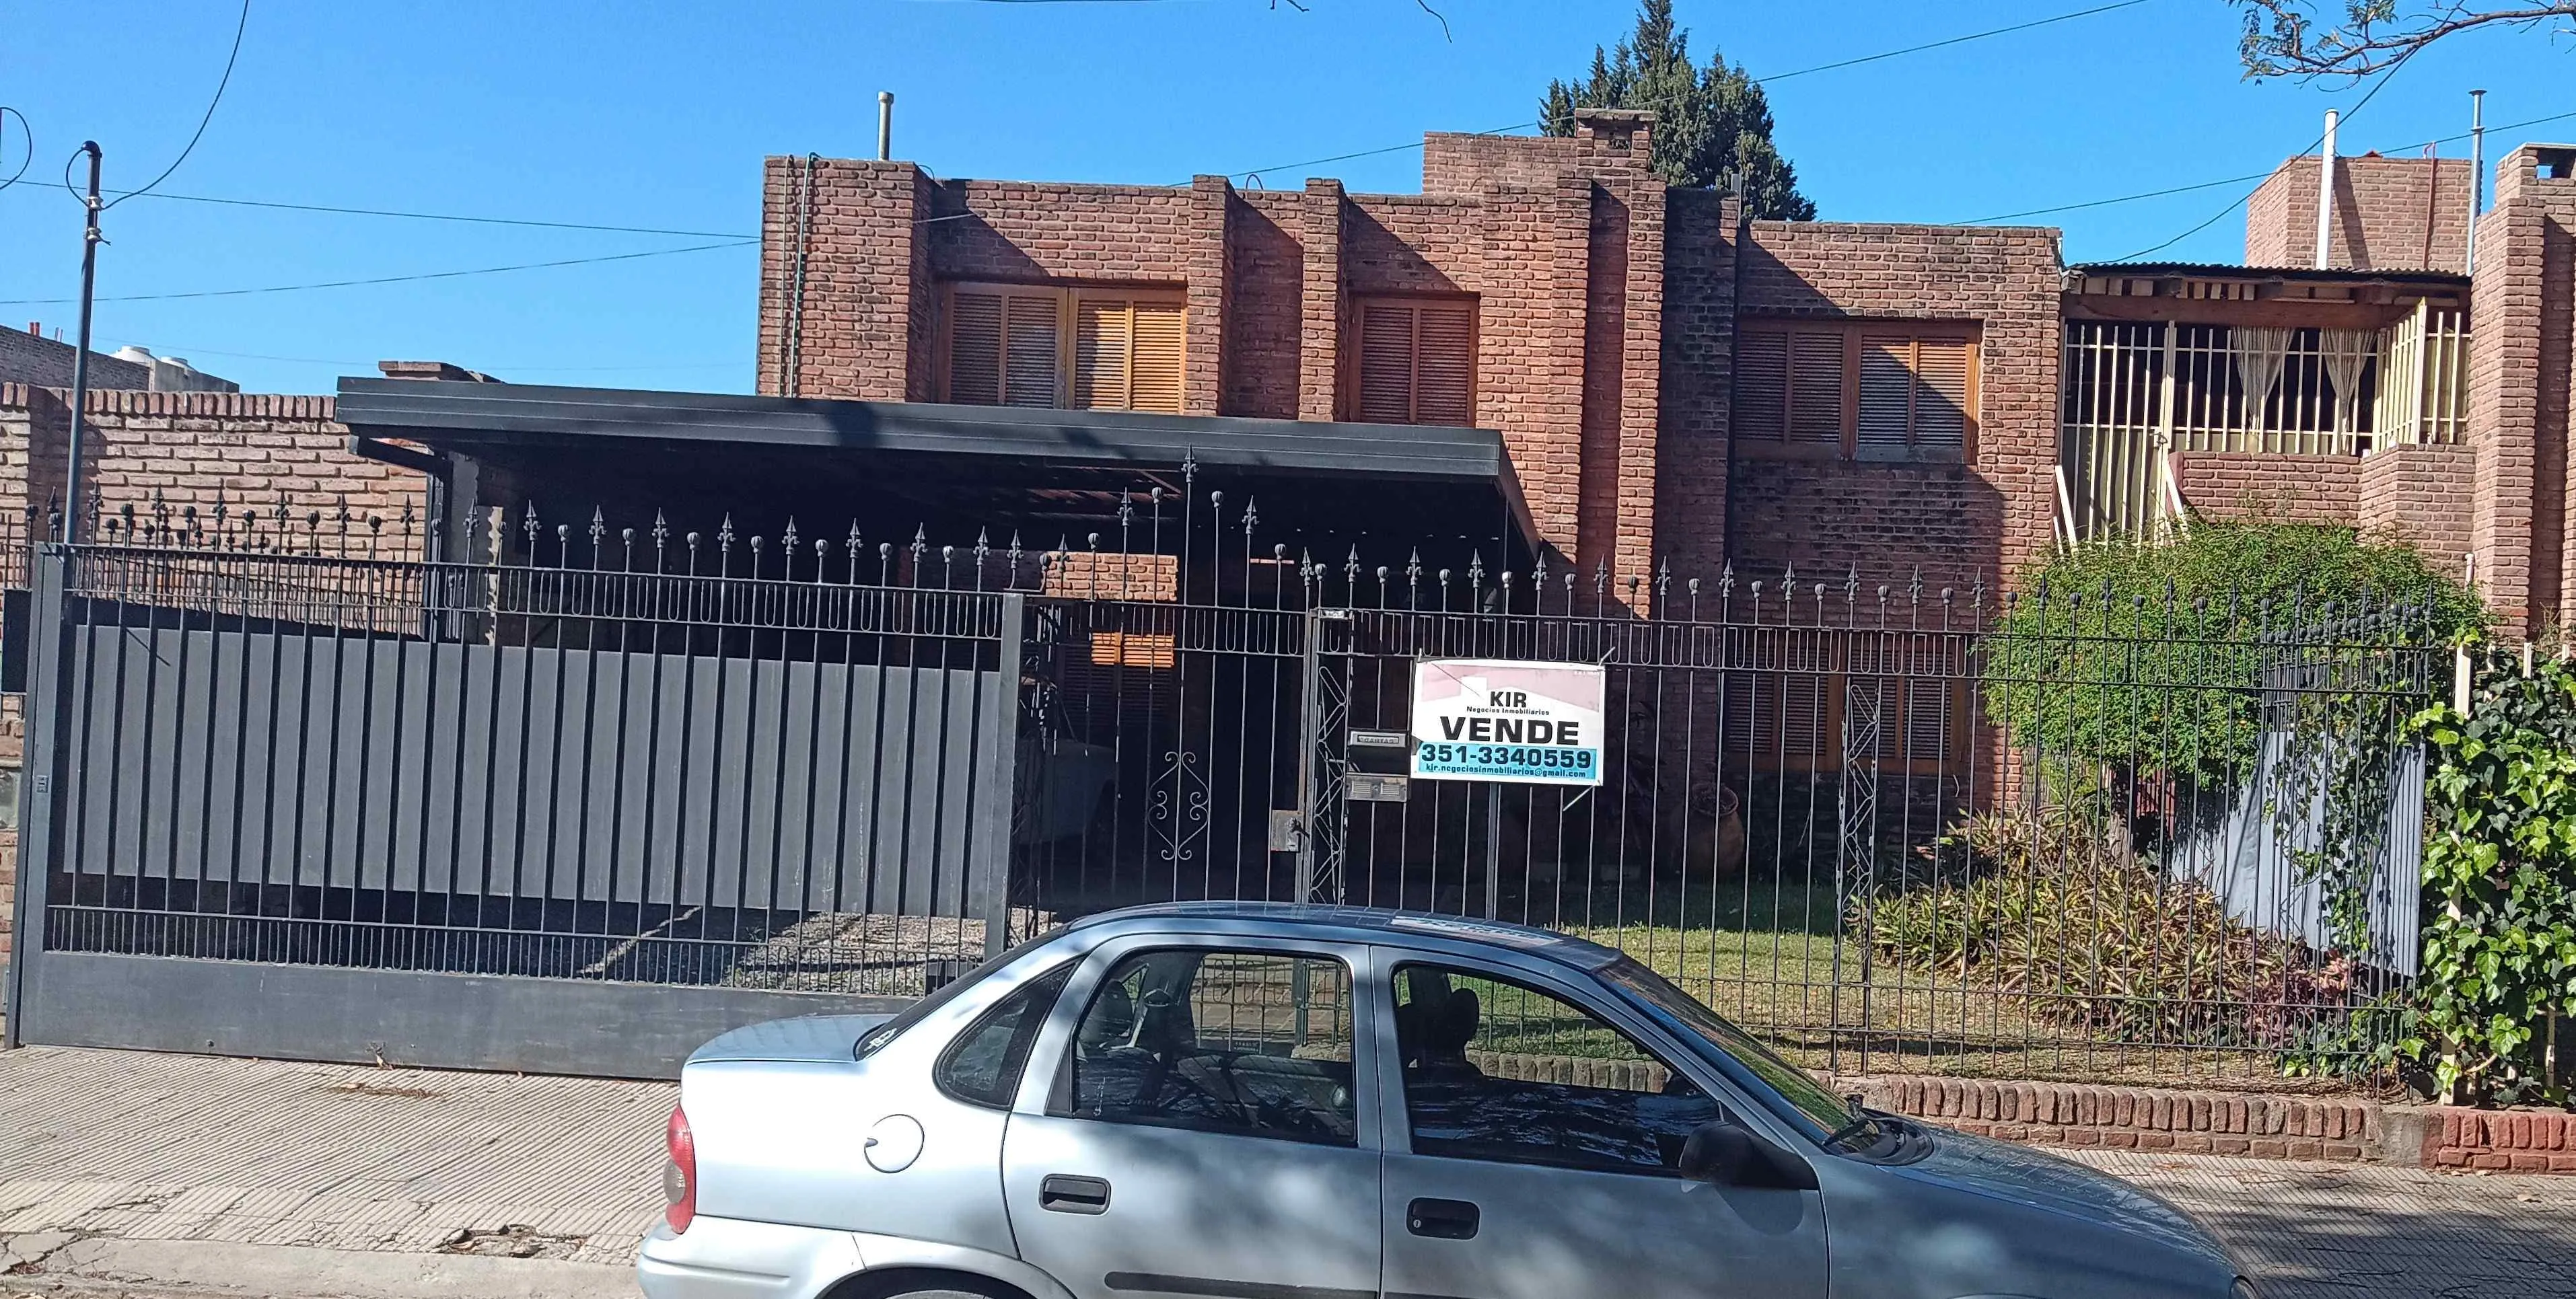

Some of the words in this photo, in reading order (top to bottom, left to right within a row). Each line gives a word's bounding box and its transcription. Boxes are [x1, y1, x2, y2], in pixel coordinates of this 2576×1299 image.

[1490, 691, 1527, 708] KIR
[1466, 706, 1500, 714] Negocios
[1502, 708, 1550, 716] Inmobiliarios
[1440, 716, 1579, 745] VENDE
[1421, 743, 1591, 768] 351-3340559
